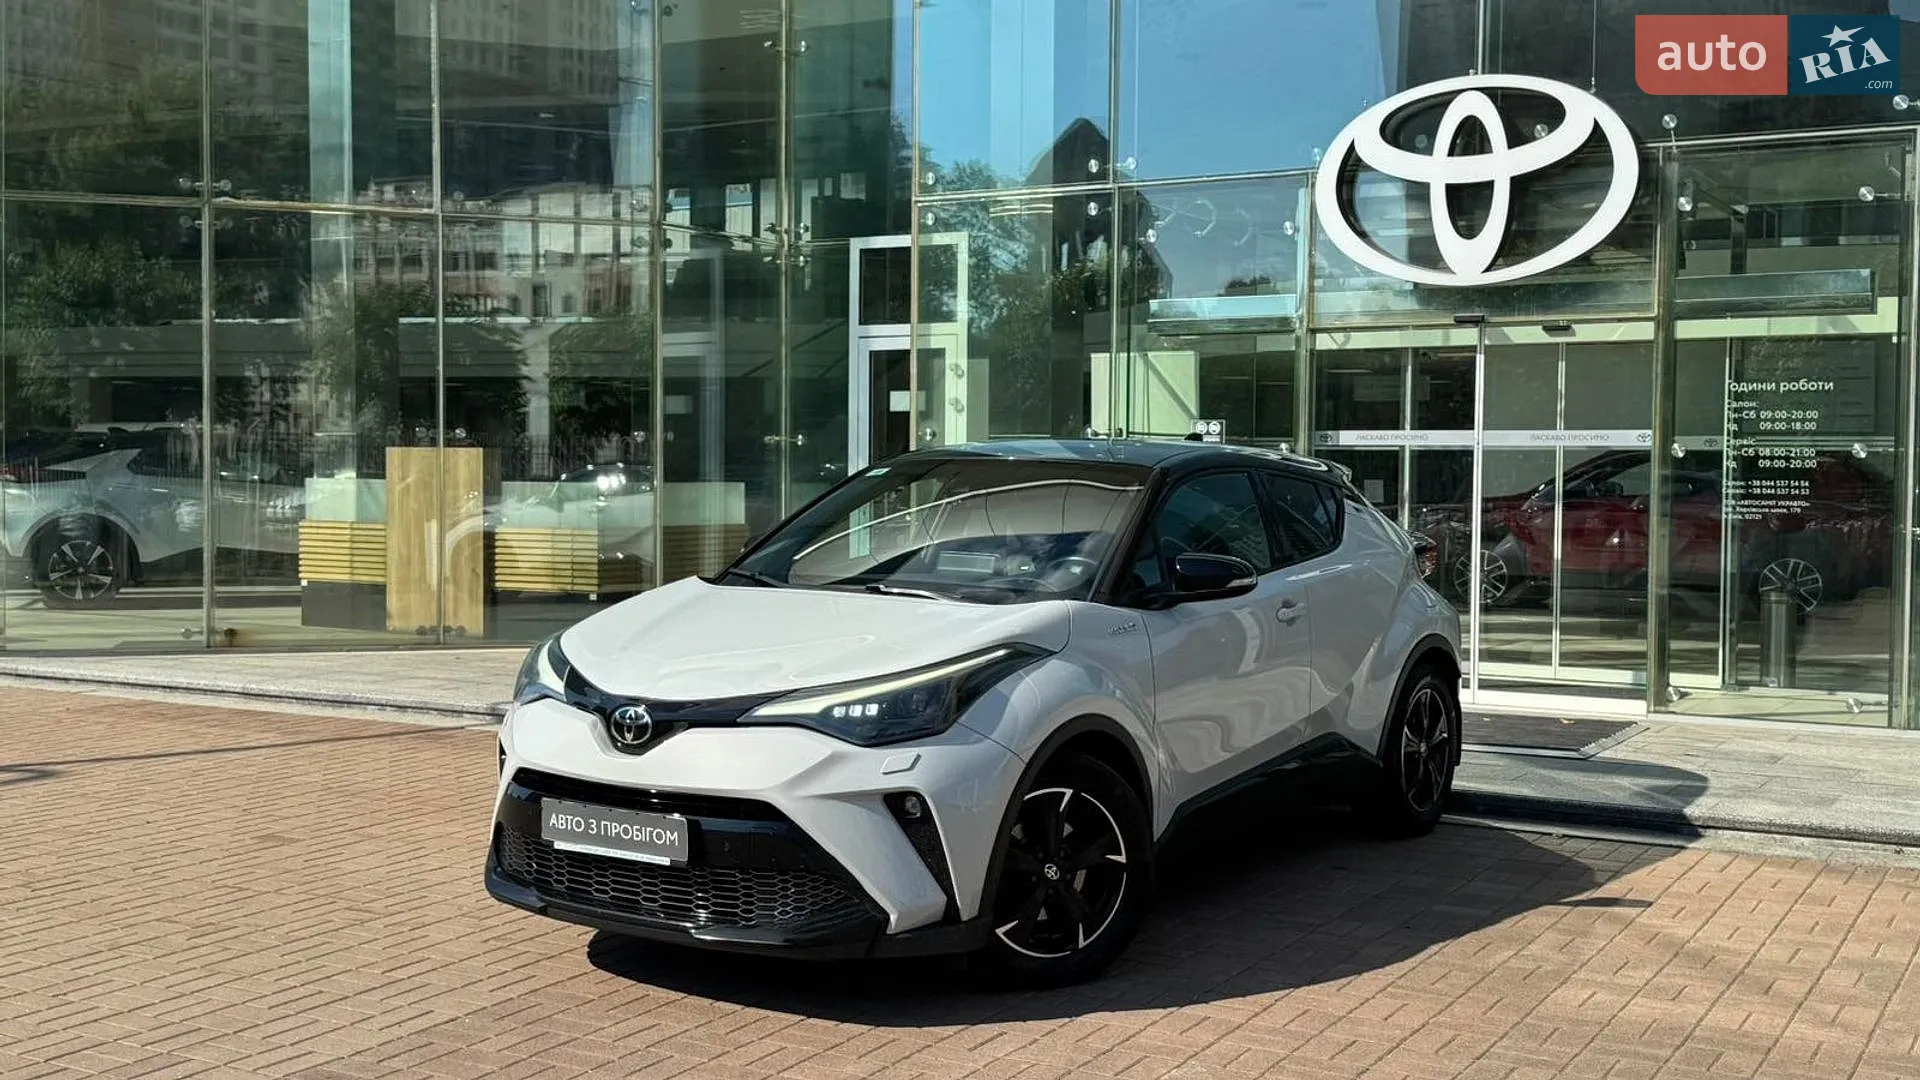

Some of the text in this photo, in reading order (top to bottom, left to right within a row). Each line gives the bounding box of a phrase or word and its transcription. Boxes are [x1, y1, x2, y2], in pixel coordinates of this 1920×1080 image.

[1779, 378, 1834, 393] роботи
[1759, 410, 1819, 419] 09:00-20:00
[1759, 422, 1817, 430] 09:00-18:00
[1758, 447, 1816, 457] 08:00-21:00
[1758, 459, 1817, 468] 09:00-20:00
[549, 813, 585, 832] АВТО
[601, 820, 678, 846] ПРОБІГОМ
